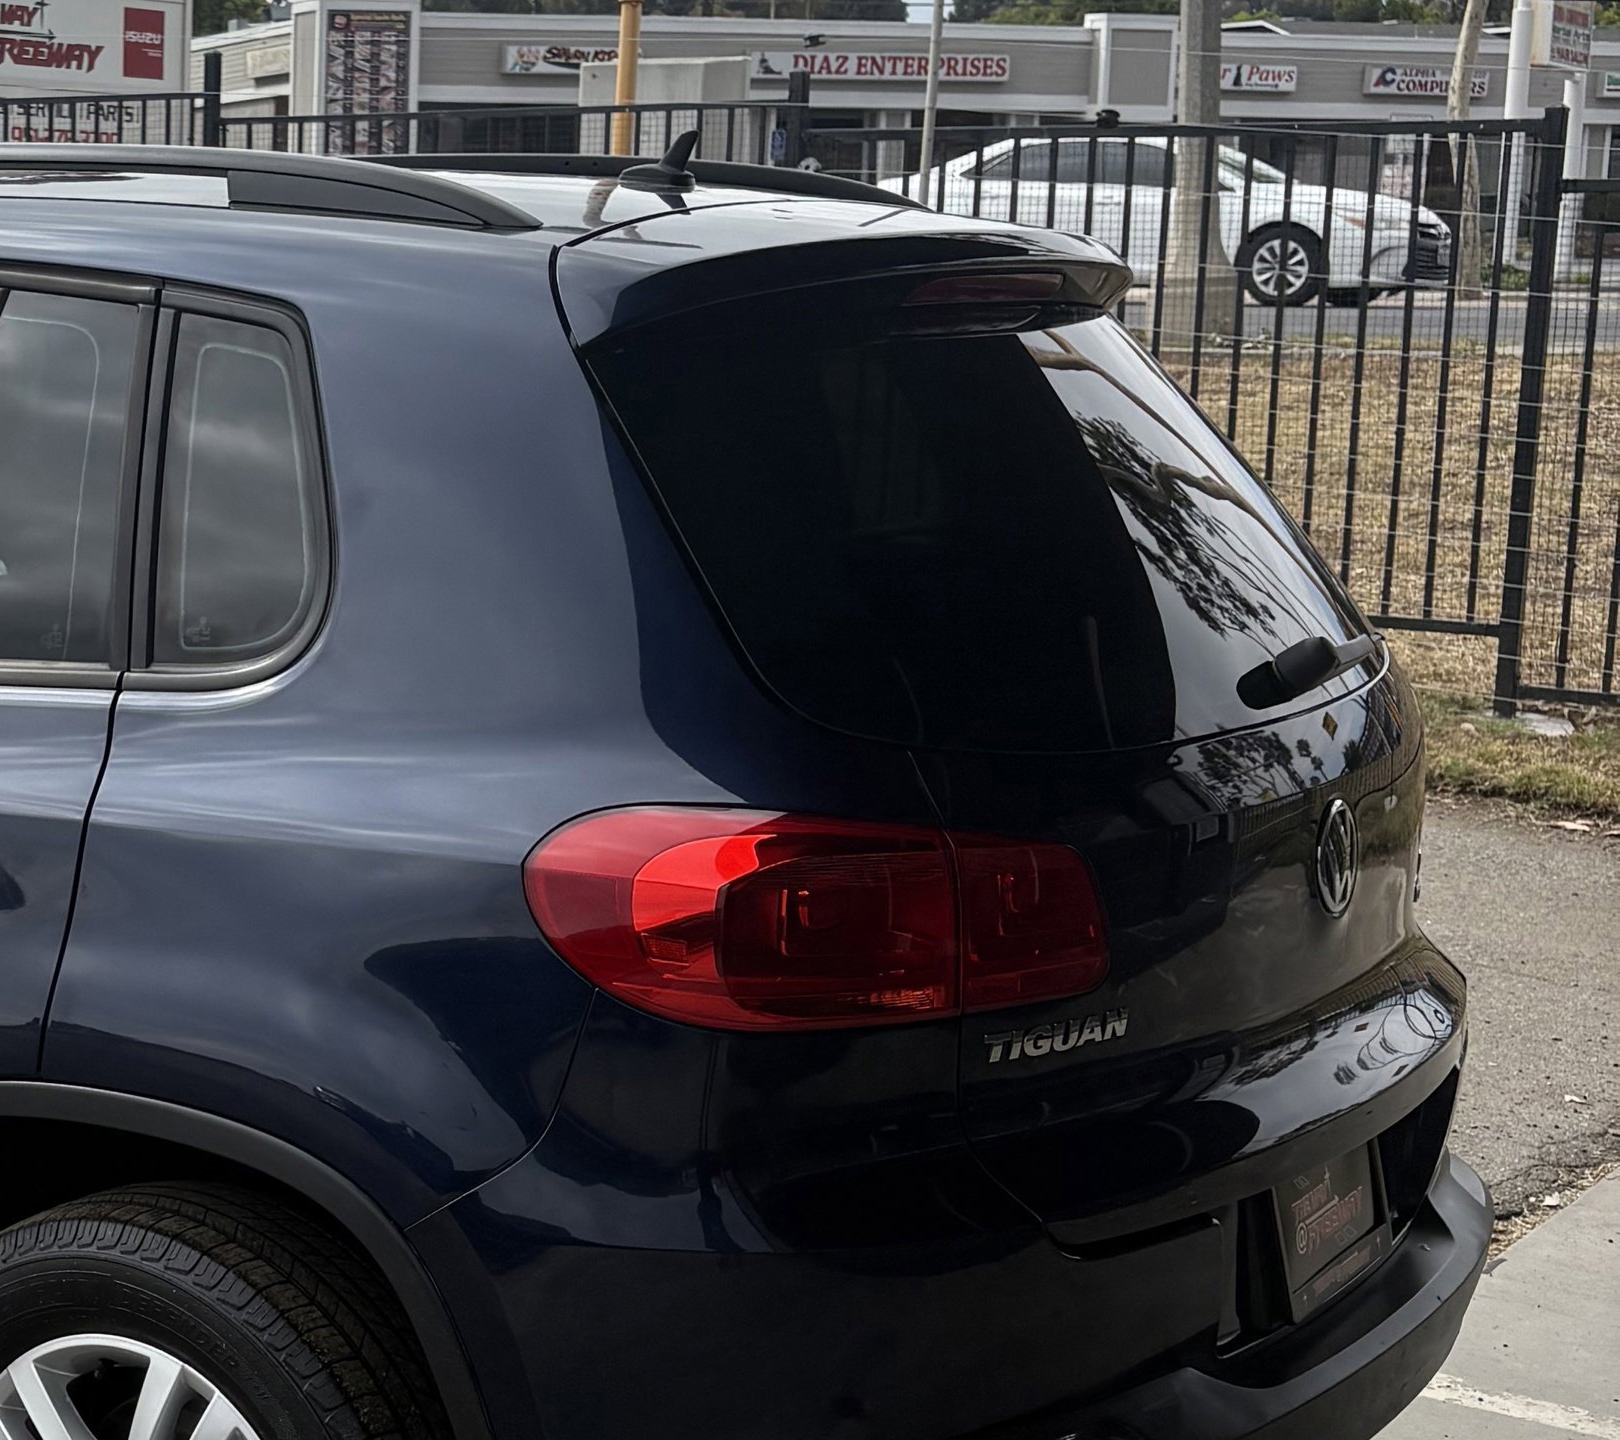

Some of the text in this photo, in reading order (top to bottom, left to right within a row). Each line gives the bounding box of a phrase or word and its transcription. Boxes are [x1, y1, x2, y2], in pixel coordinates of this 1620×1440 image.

[0, 3, 39, 27] WAY
[125, 31, 162, 44] ISUZU
[793, 54, 1007, 77] DIAZ ENTERPRISES
[1247, 65, 1295, 83] Paws
[1396, 78, 1486, 95] COMPURS
[984, 1008, 1130, 1063] TIGUAN
